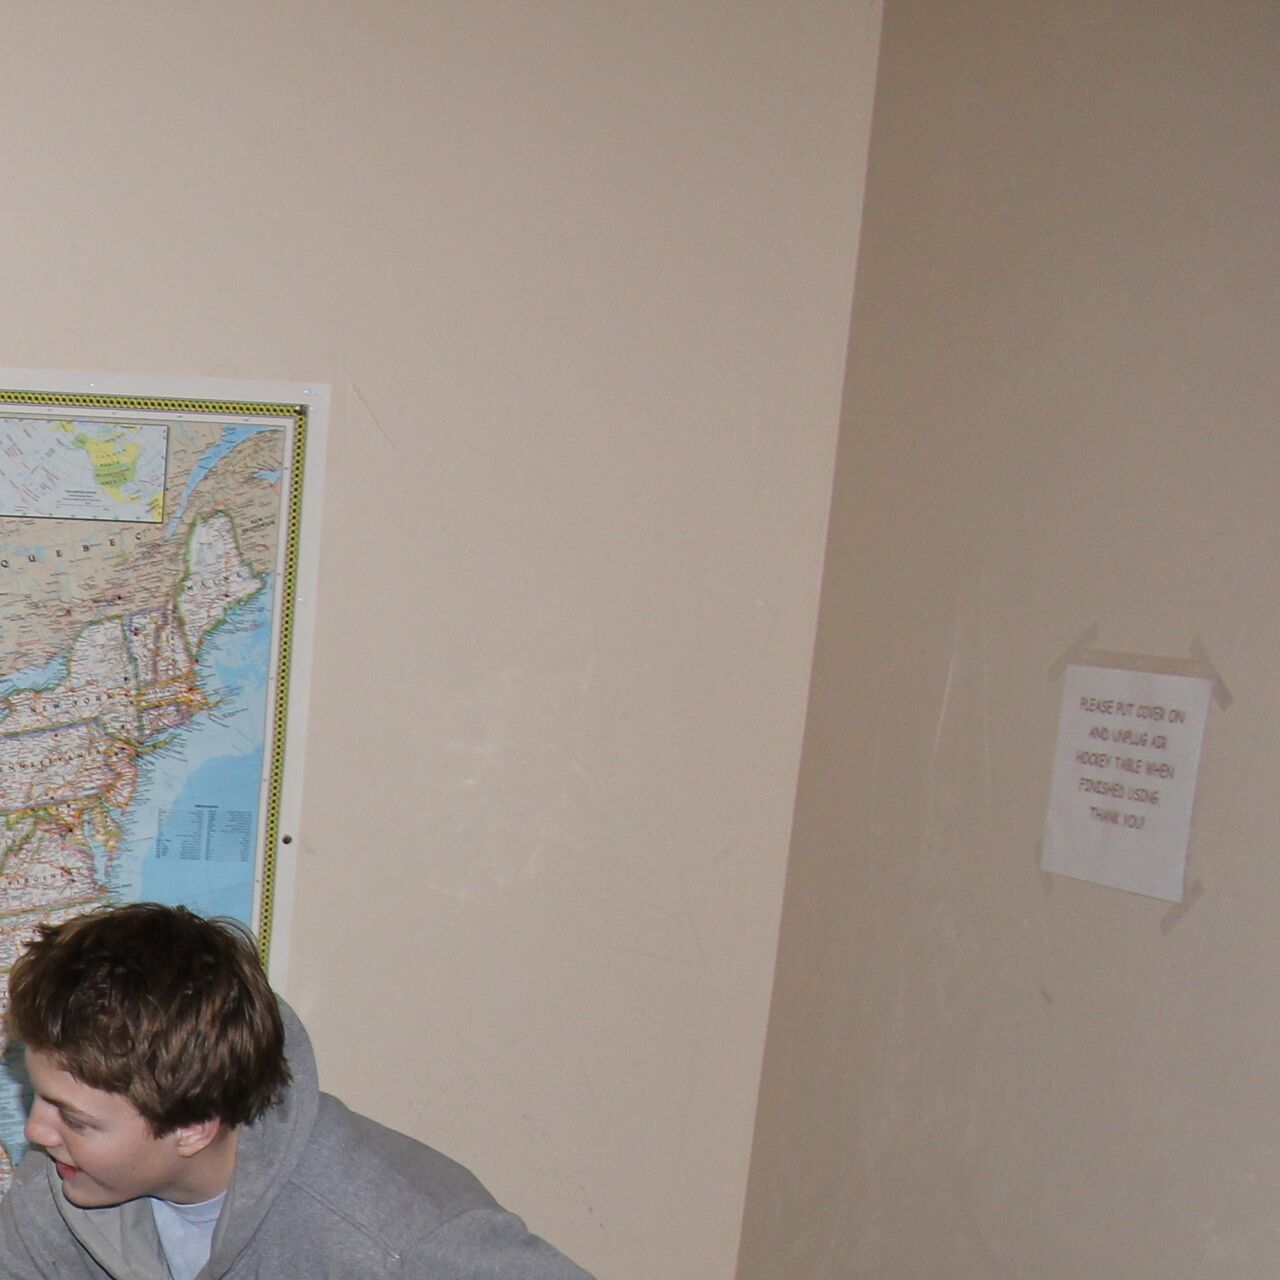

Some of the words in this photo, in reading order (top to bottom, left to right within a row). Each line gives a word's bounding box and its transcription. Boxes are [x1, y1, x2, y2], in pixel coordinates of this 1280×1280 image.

[1079, 696, 1113, 716] PLEASE
[1116, 700, 1135, 717] PUT
[1136, 705, 1166, 722] COVER
[1089, 727, 1109, 742] AND
[1112, 729, 1148, 747] UNPLUG
[1151, 733, 1167, 750] AIR
[1076, 751, 1110, 769] HOCKEY
[1114, 756, 1142, 775] TABLE
[1144, 761, 1174, 780] WHEN
[1079, 776, 1125, 800] FINISHED
[1089, 805, 1118, 826] THANK
